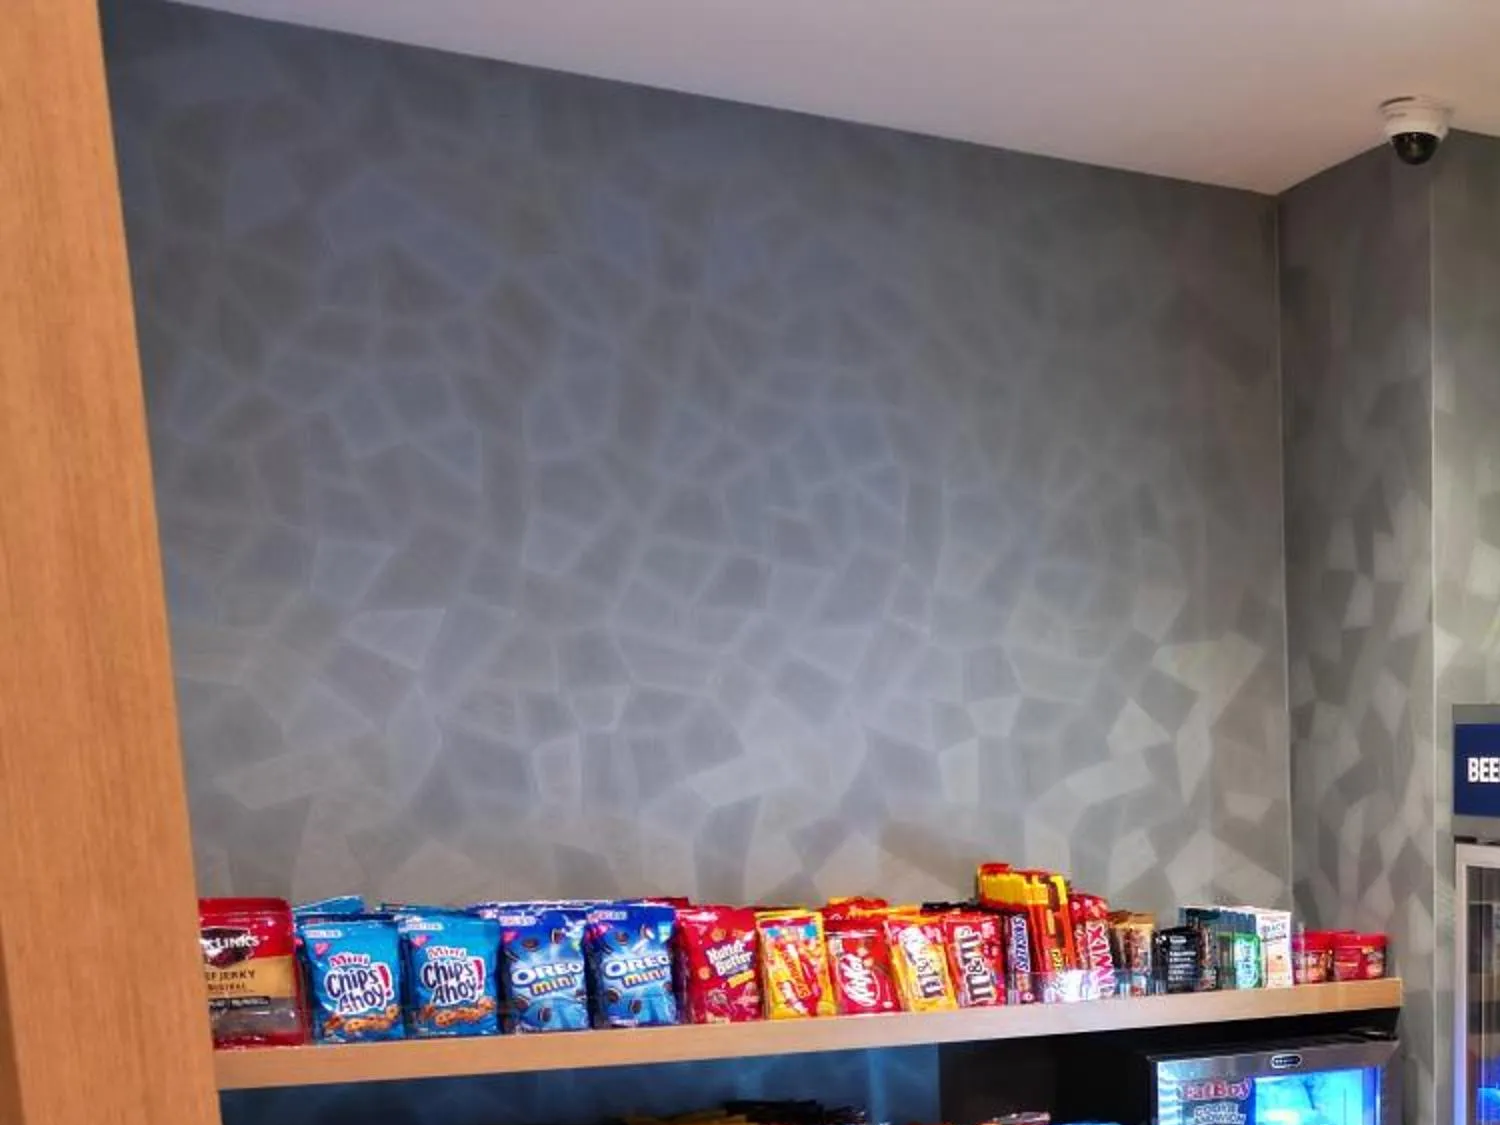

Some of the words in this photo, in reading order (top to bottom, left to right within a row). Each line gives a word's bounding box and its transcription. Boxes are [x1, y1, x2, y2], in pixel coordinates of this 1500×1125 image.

[422, 961, 474, 989] Chips
[512, 962, 582, 985] OREO
[605, 955, 670, 977] OREO
[326, 968, 379, 998] Chips
